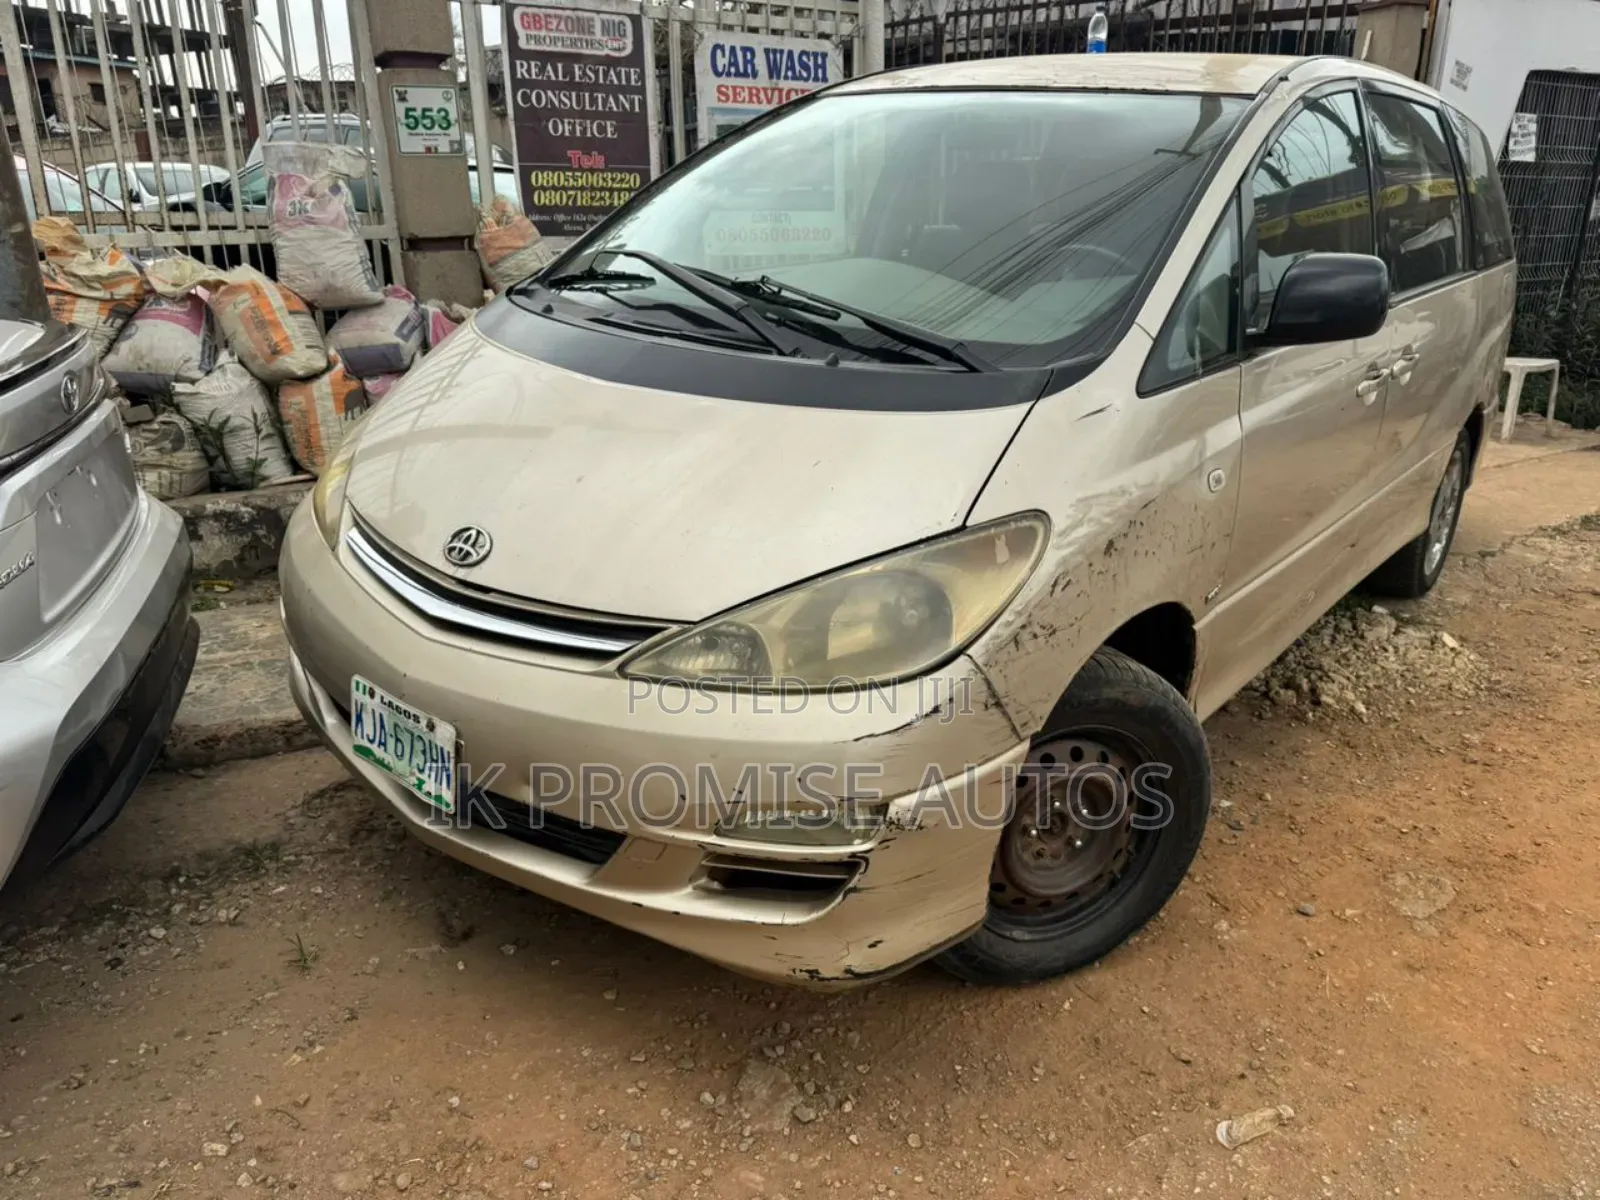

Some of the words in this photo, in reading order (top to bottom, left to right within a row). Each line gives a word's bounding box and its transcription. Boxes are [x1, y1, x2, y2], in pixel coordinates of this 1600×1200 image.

[520, 12, 596, 36] GBEZONE
[601, 18, 627, 38] NIG
[525, 33, 605, 50] PROPERTIES
[515, 60, 570, 82] REAL
[574, 64, 642, 86] ESTATE
[710, 44, 759, 79] CAR
[763, 48, 829, 83] WASH
[516, 88, 643, 113] CONSULTANT
[404, 107, 452, 131] 553
[548, 117, 618, 139] OFFICE
[530, 170, 641, 189] 08055063220
[533, 189, 638, 207] 0807182348
[380, 694, 421, 725] LAGOS
